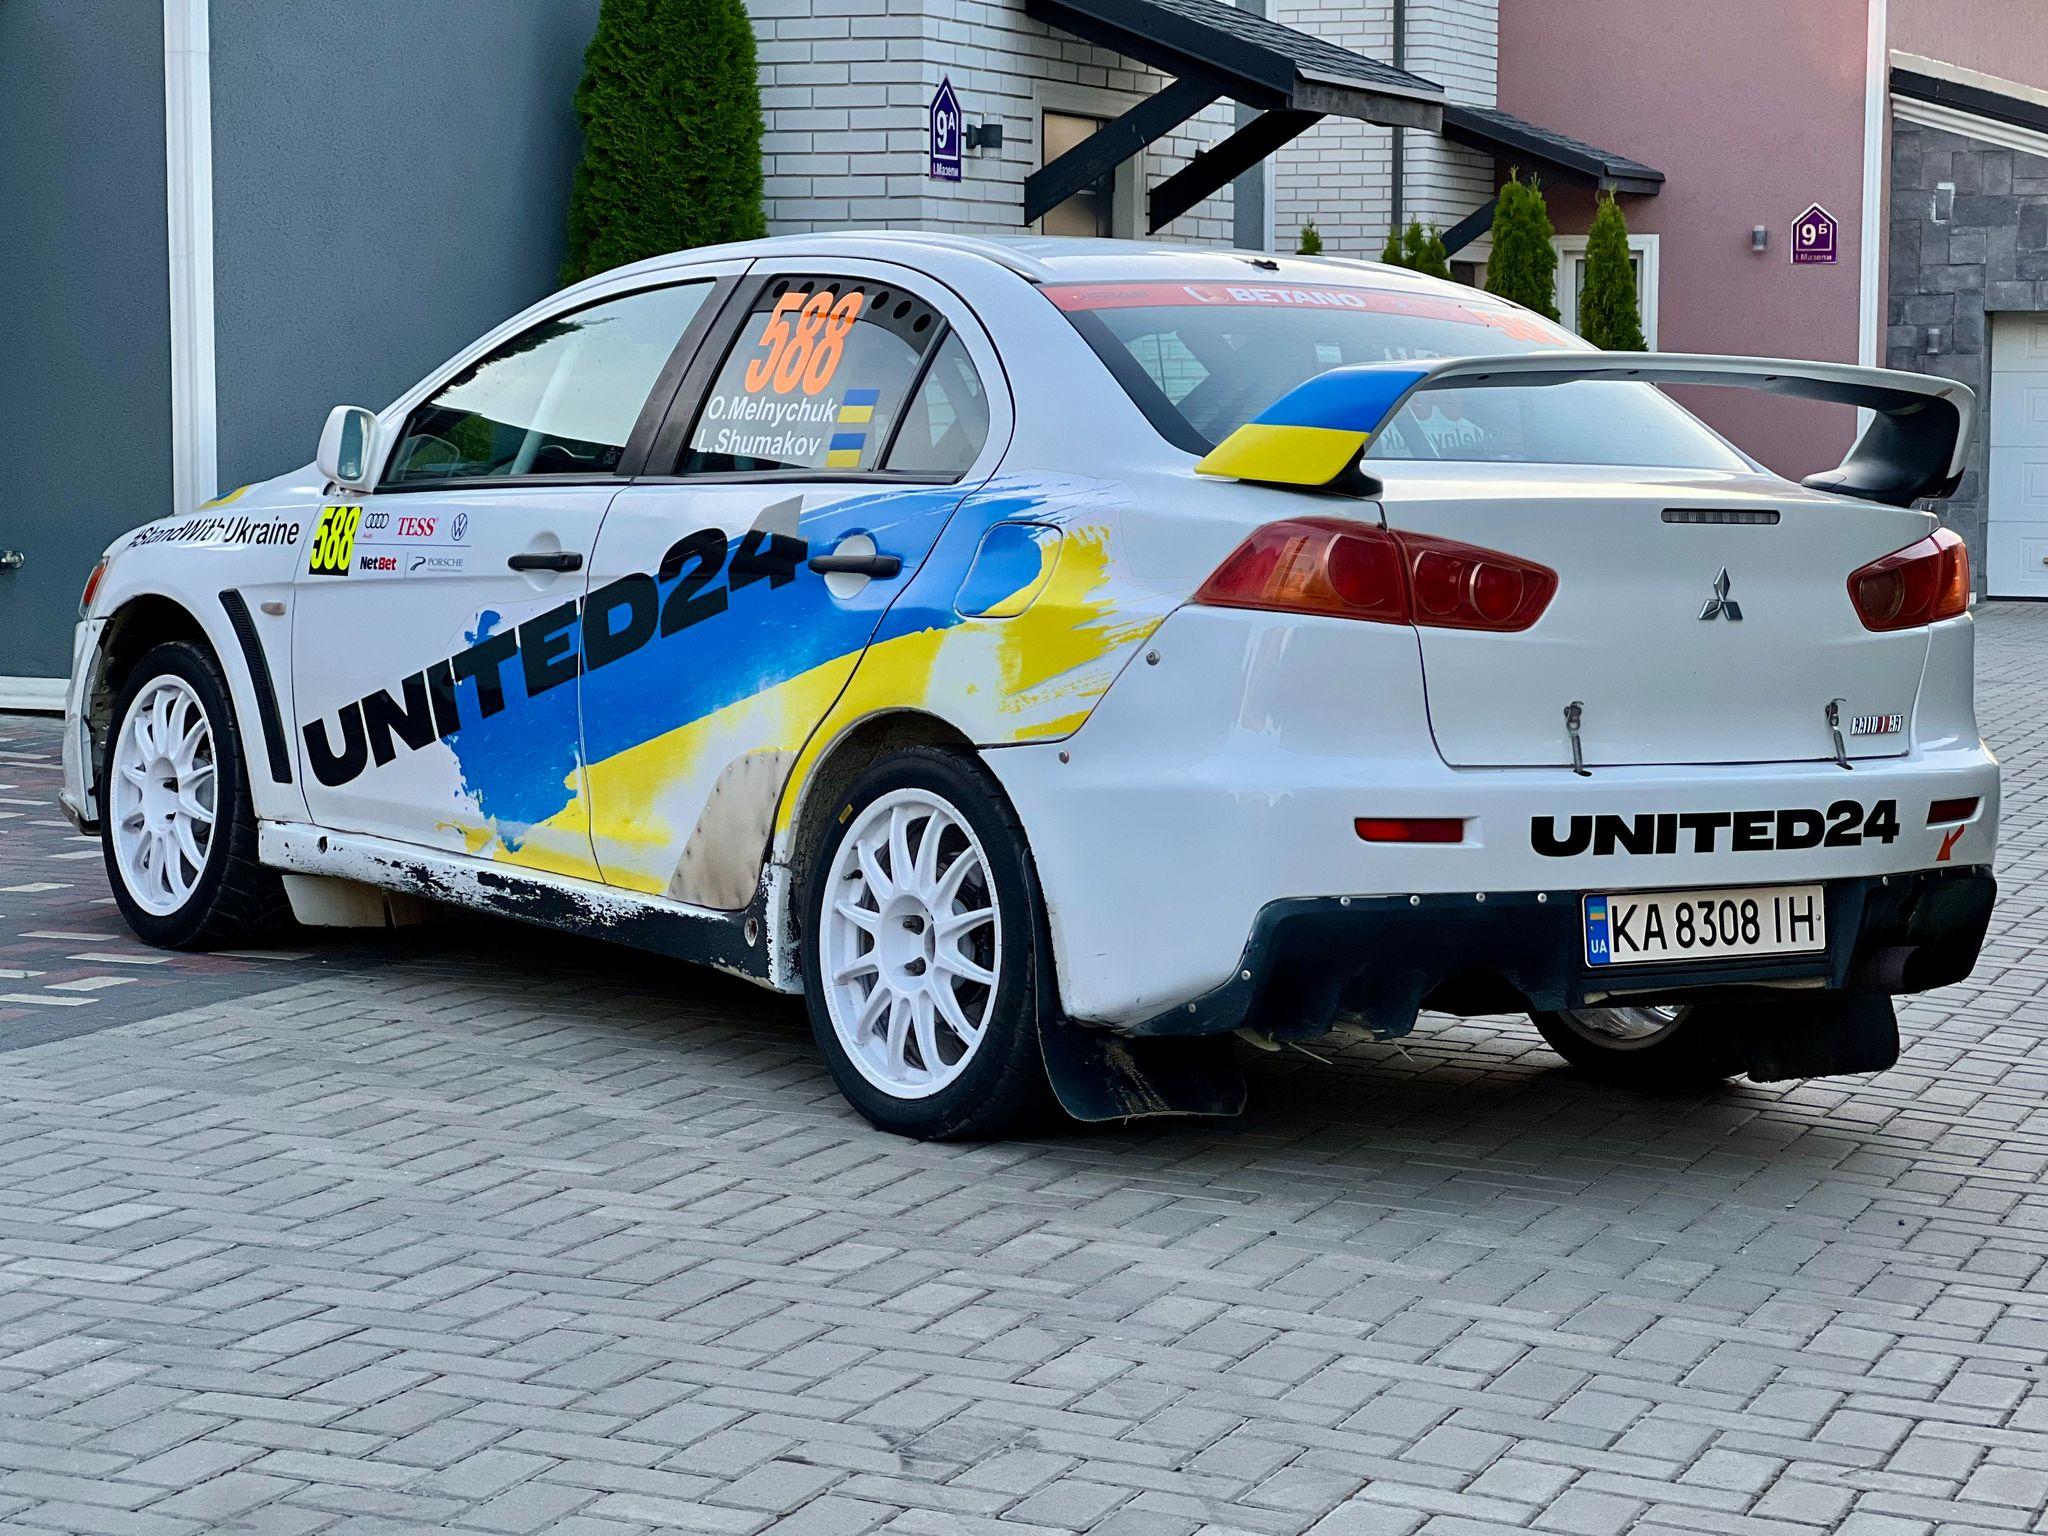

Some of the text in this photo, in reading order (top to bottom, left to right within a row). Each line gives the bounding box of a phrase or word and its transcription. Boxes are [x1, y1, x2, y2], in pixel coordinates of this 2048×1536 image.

[1226, 287, 1366, 308] BETANO
[743, 290, 864, 396] 588
[707, 395, 838, 428] O.Melnychuk
[696, 428, 822, 456] L.Shumakov
[128, 515, 300, 549] #StandWithUkraine
[311, 505, 361, 571] 588
[397, 517, 436, 537] TESS
[359, 556, 397, 571] NetBet
[427, 557, 464, 567] PORSCHE
[302, 494, 809, 788] UNITED24
[1530, 799, 1900, 858] UNITED24
[1611, 895, 1815, 953] KA 8308 IH
[1591, 938, 1608, 954] UA
